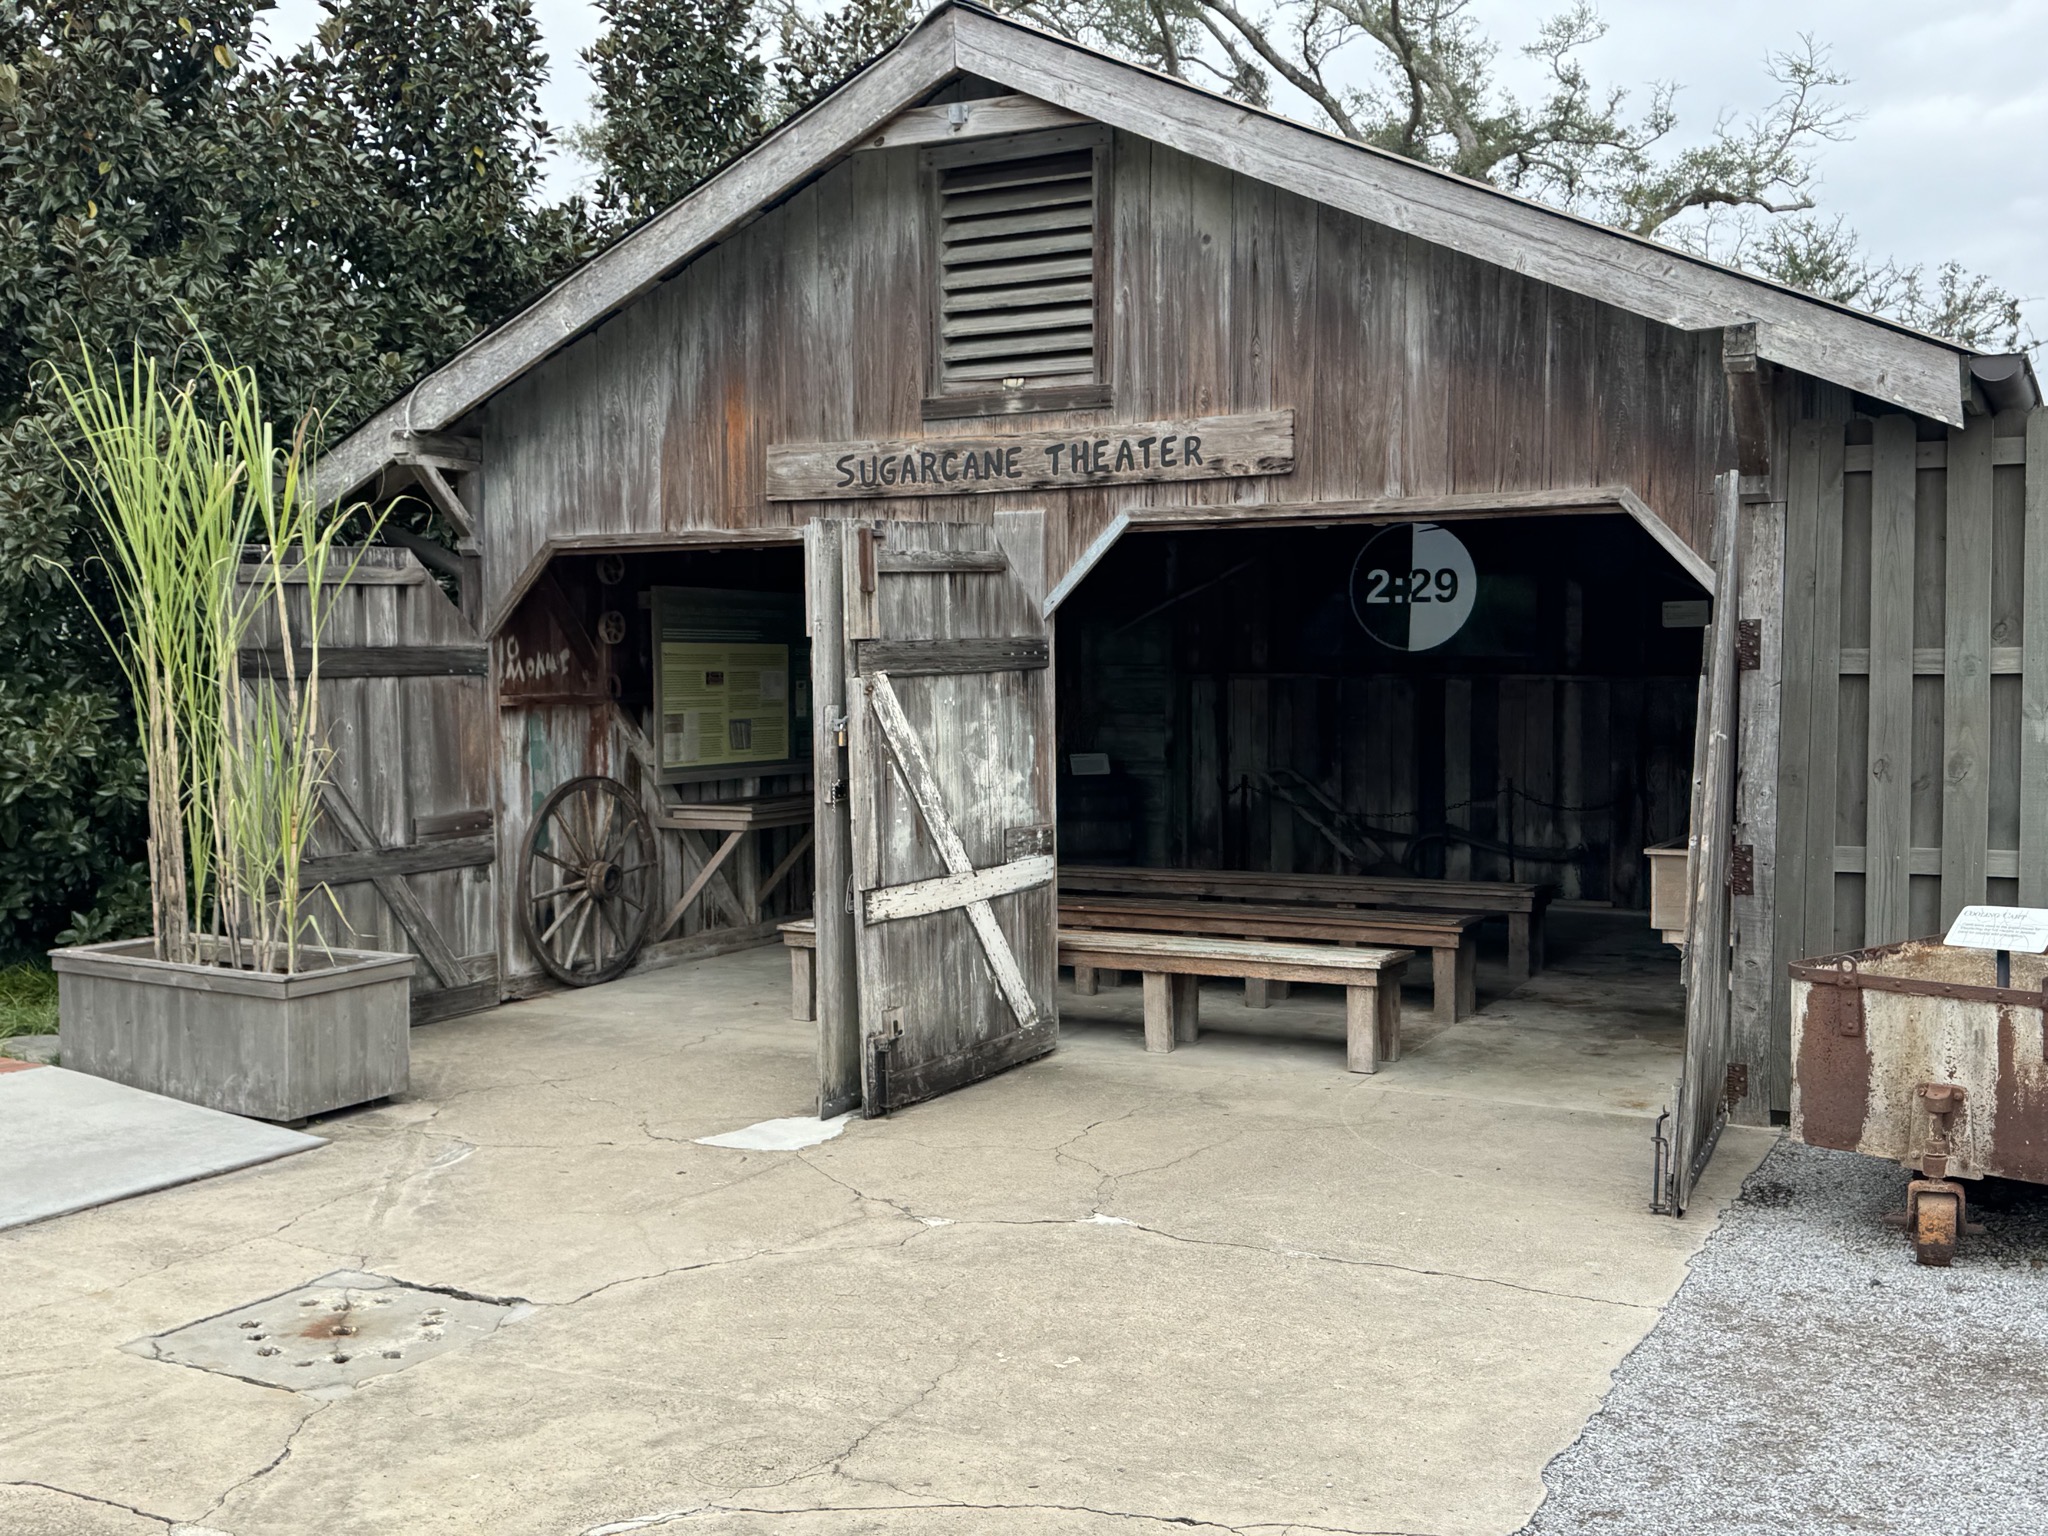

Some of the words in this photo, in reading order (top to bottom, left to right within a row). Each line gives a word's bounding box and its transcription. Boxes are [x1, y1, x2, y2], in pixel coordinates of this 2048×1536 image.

[836, 447, 1023, 488] SUGARCANE
[1044, 435, 1204, 475] THEATER
[1366, 568, 1458, 603] 2:29
